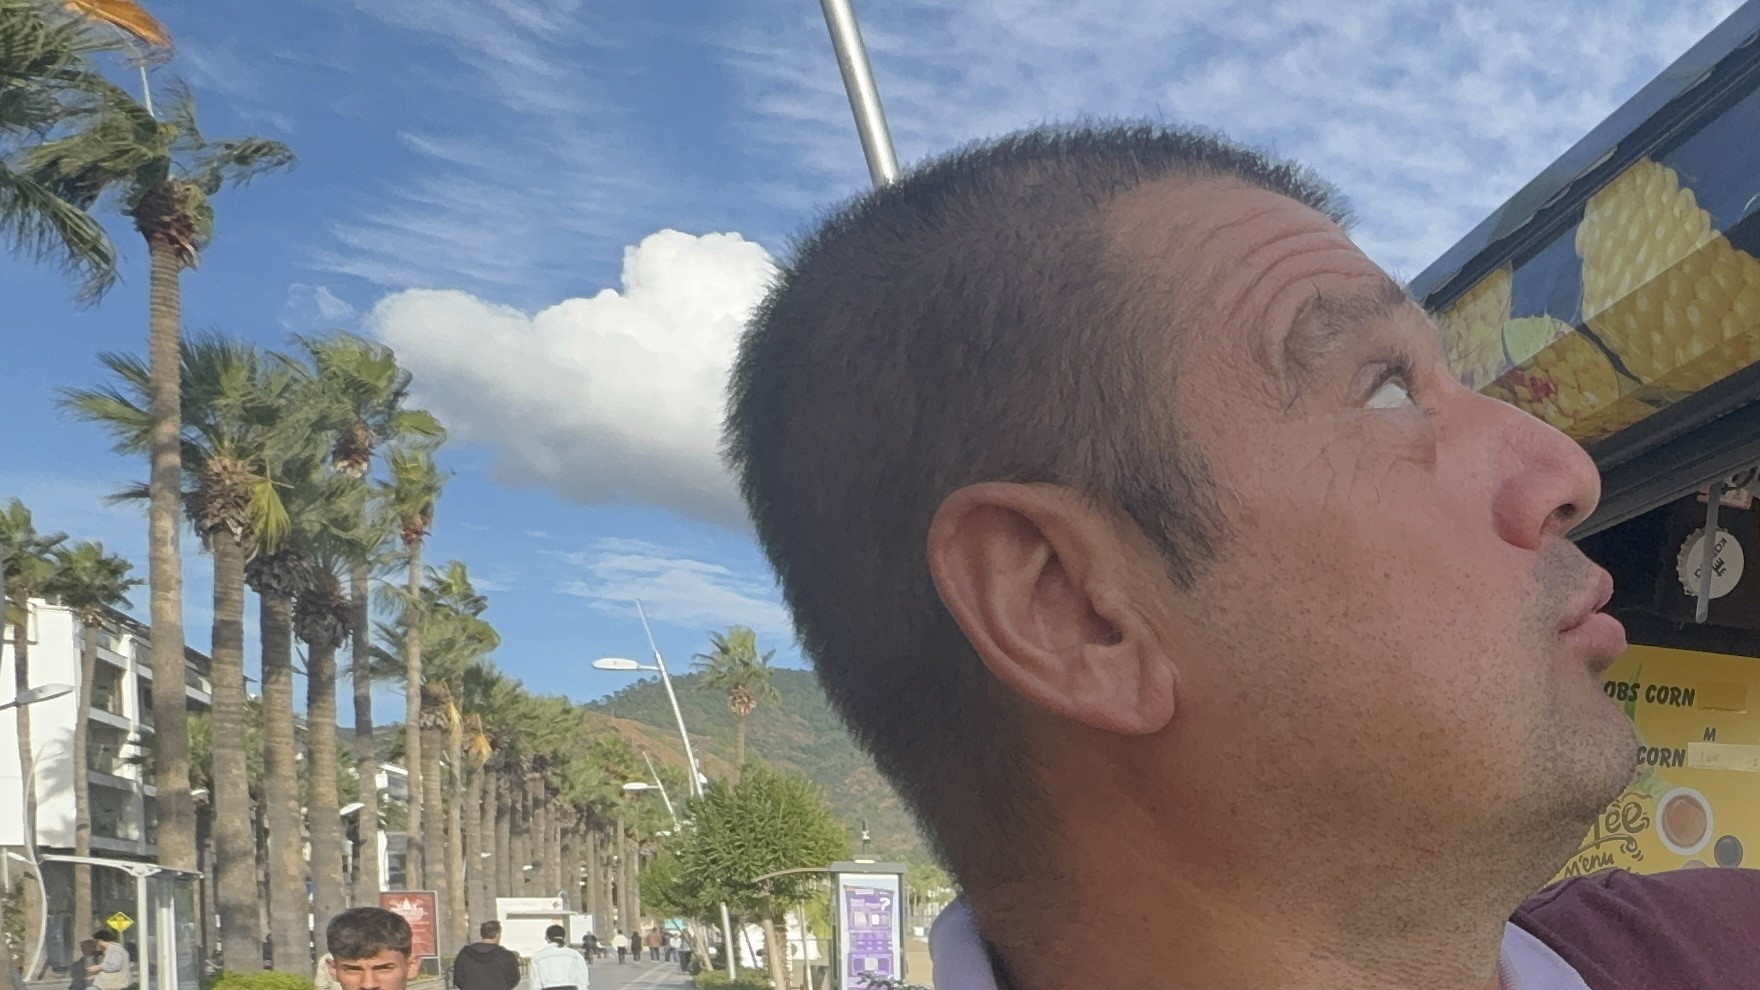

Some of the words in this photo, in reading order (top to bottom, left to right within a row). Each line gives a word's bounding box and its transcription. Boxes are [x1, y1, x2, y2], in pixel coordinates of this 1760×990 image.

[1645, 684, 1695, 708] CORN
[1703, 726, 1717, 743] M
[1636, 745, 1686, 769] CORN
